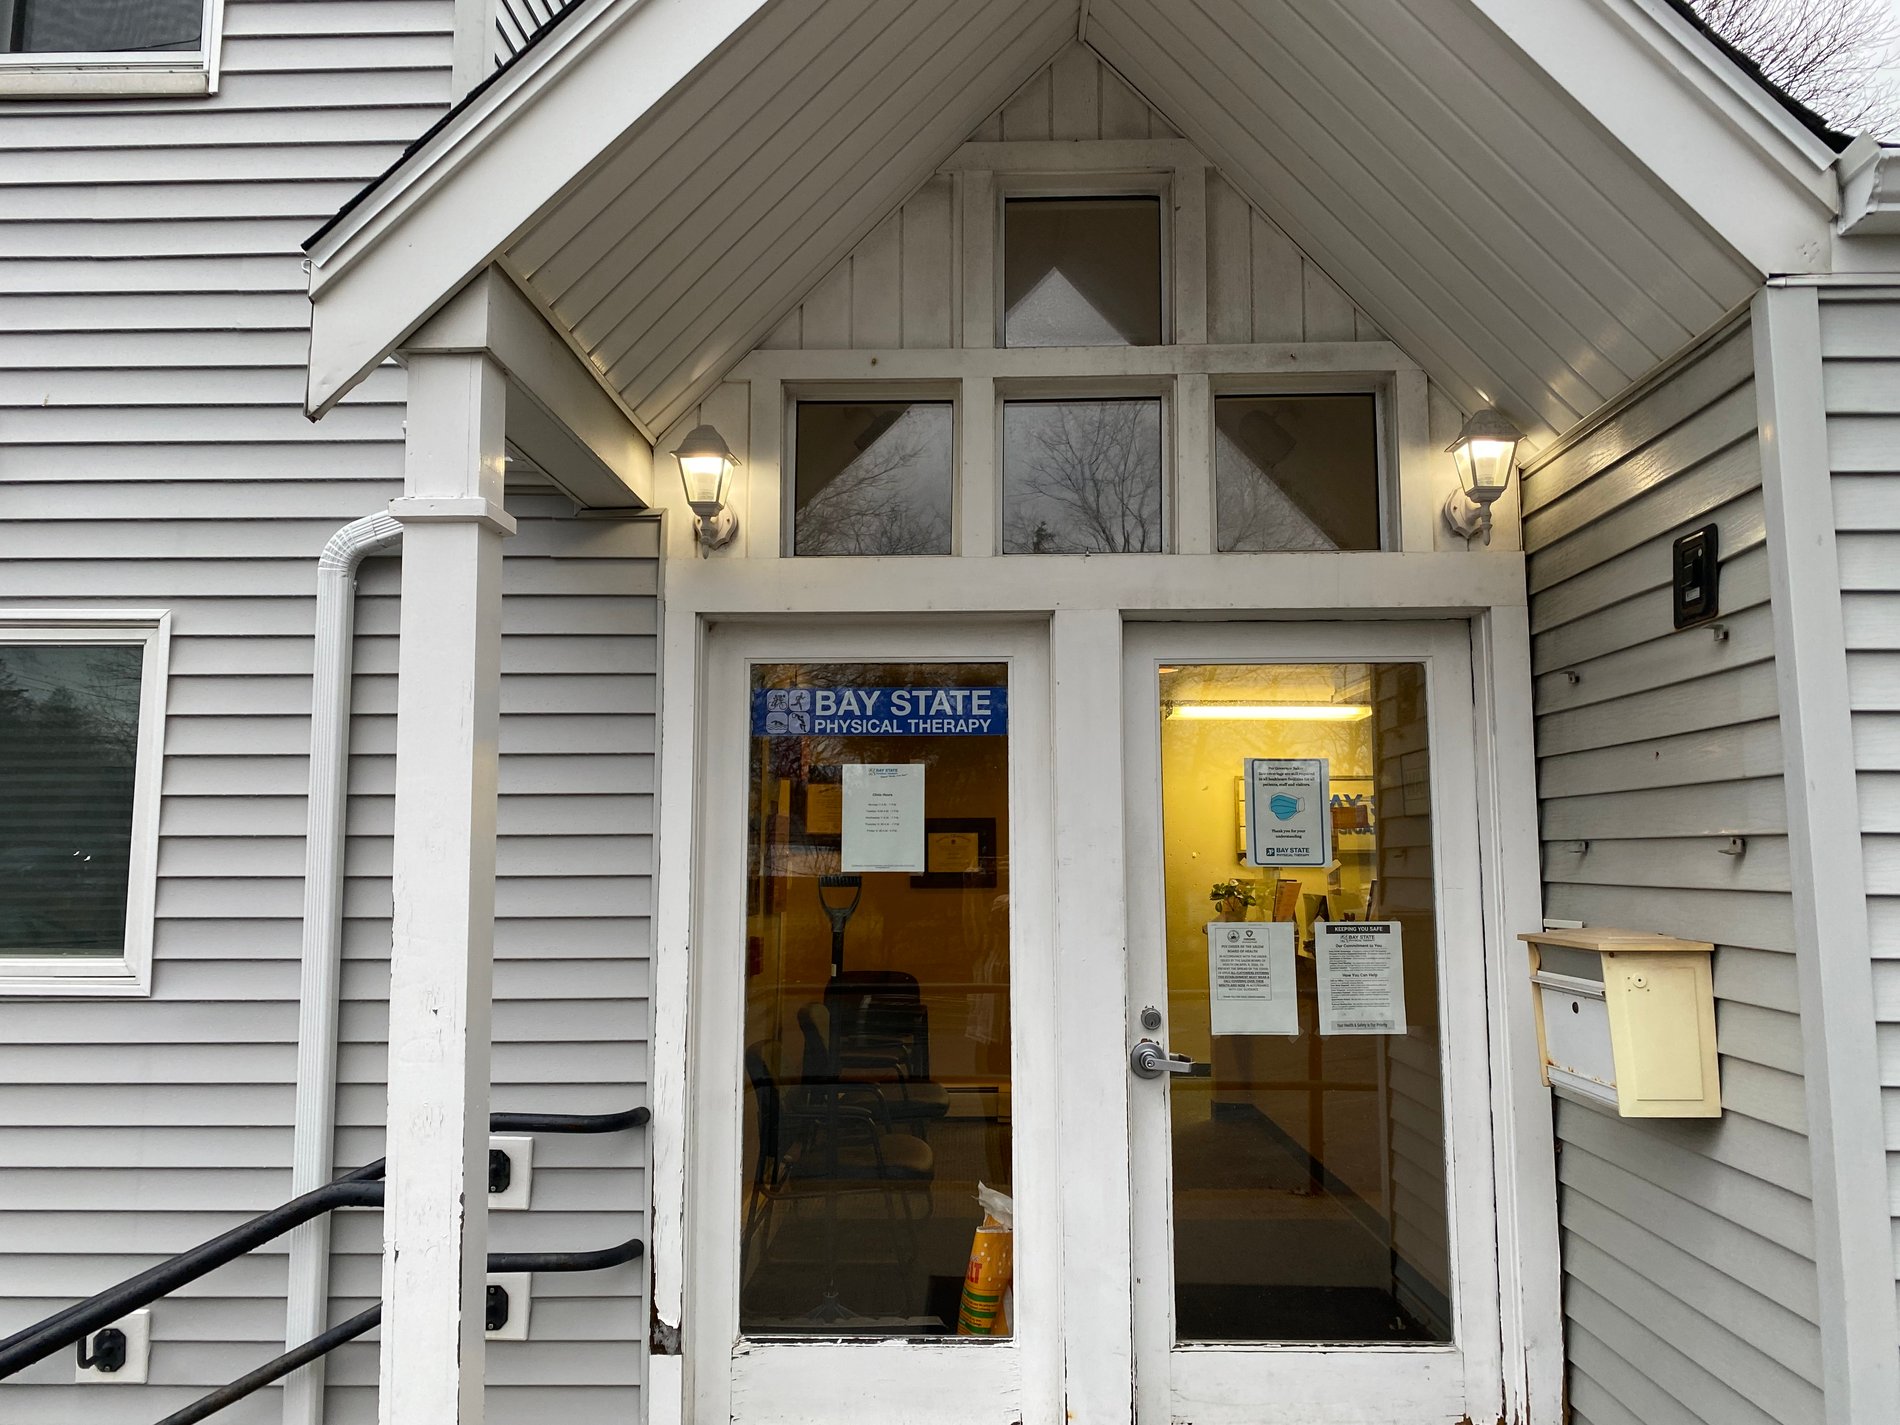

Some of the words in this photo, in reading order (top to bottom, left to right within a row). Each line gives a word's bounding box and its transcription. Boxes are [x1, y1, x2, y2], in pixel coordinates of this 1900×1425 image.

[815, 690, 881, 716] BAY
[891, 690, 991, 716] STATE
[814, 719, 903, 734] PHYSICAL
[908, 719, 991, 734] THERAPY
